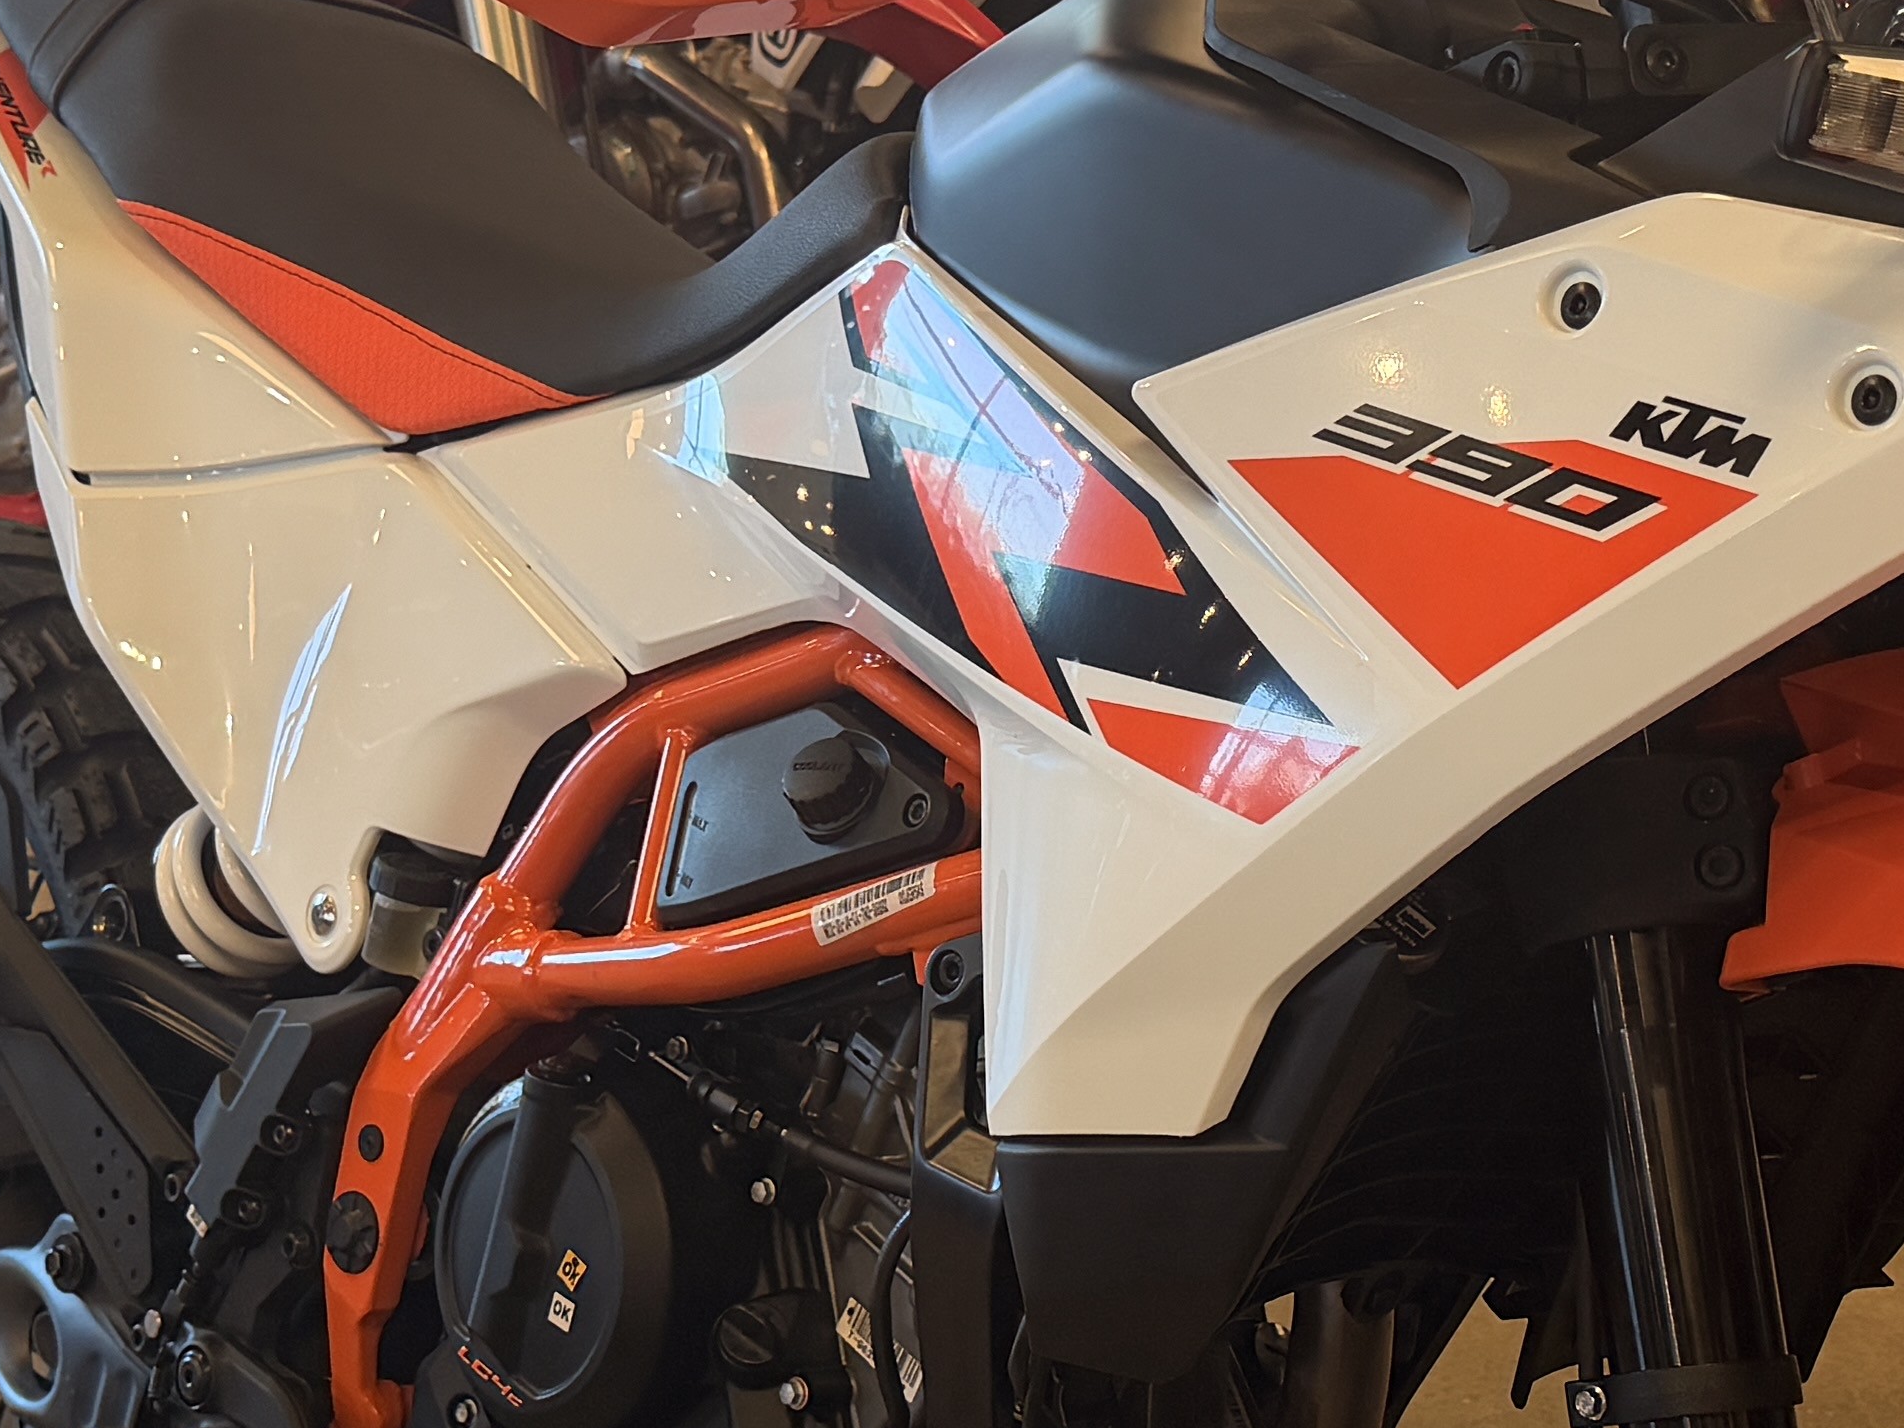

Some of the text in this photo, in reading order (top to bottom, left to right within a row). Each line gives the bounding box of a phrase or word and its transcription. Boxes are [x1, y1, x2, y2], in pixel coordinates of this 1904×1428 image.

[39, 159, 58, 179] R
[1609, 396, 1772, 477] KTM
[1312, 403, 1662, 532] 390
[562, 1260, 580, 1286] OK
[553, 1300, 572, 1322] OK
